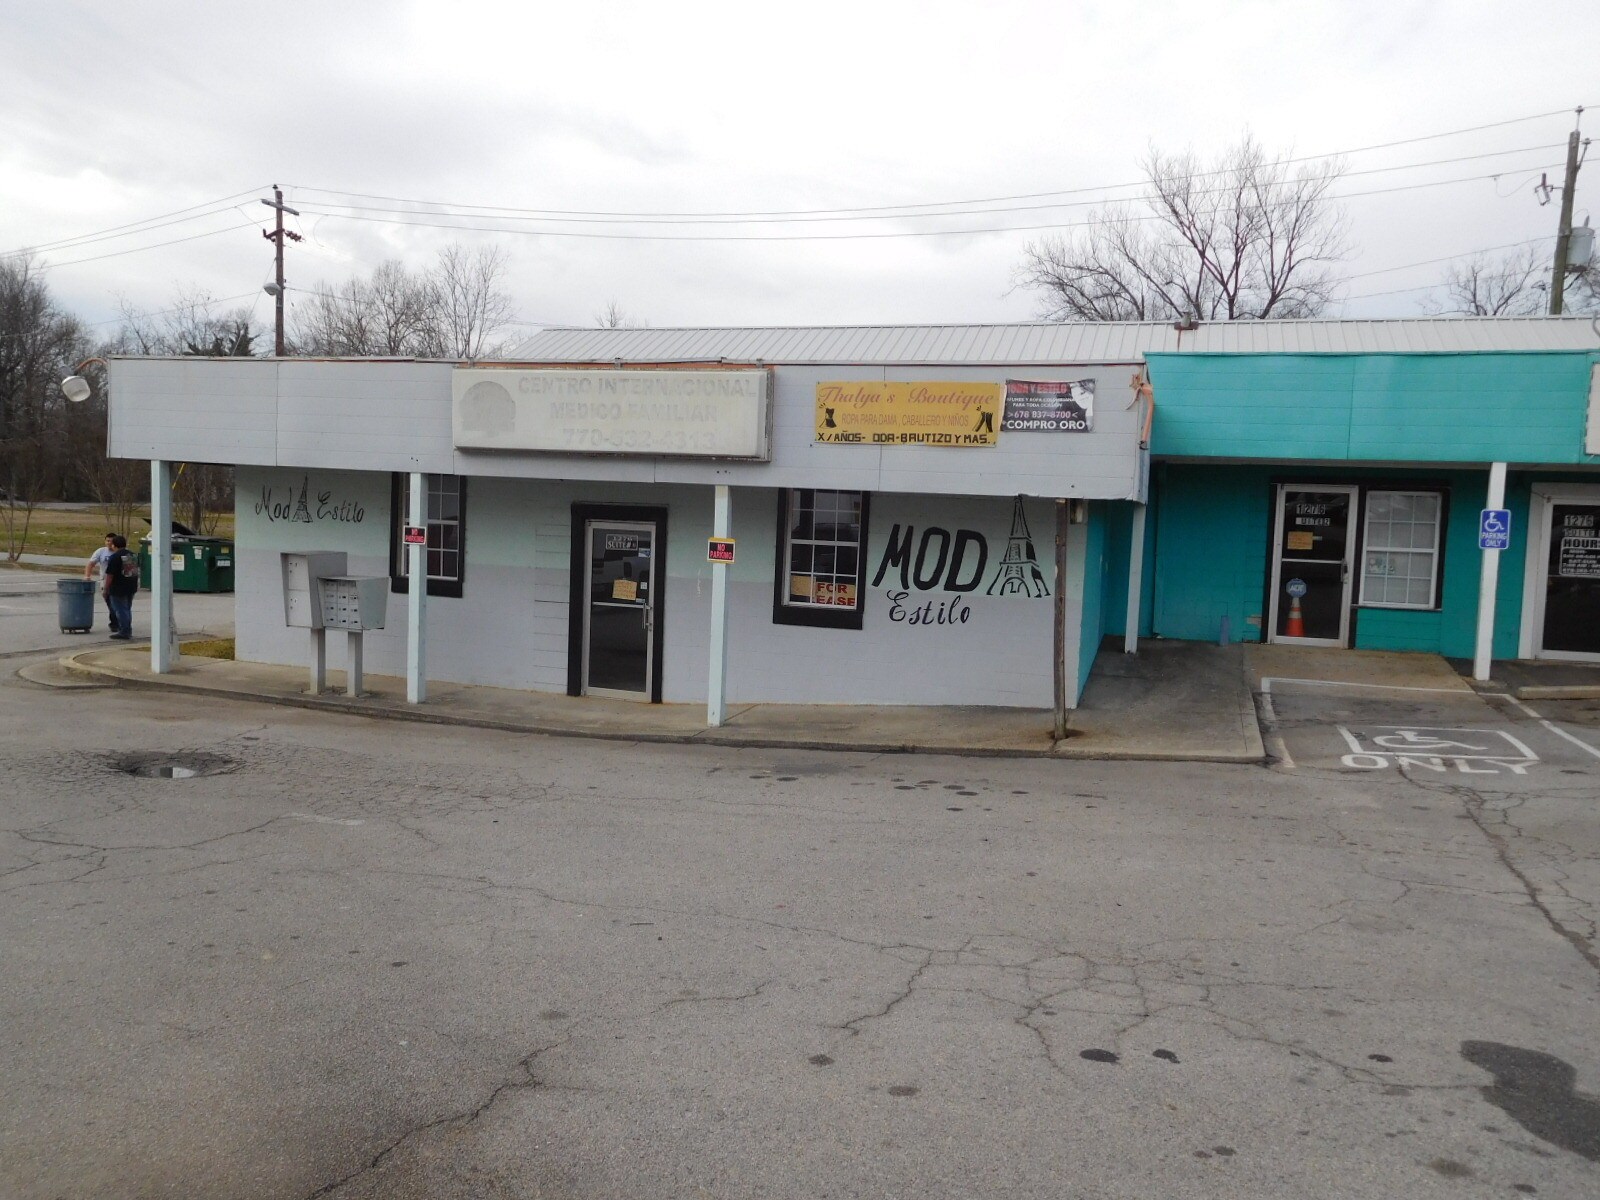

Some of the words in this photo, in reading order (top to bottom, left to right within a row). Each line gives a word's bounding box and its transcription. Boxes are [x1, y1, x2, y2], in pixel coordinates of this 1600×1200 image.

[518, 377, 592, 394] CENTRO
[598, 379, 757, 398] INTERNACIONAL
[817, 383, 896, 409] Thalya's
[908, 387, 994, 411] Boutique
[550, 402, 621, 420] MEDICO
[841, 413, 860, 424] ROPA
[860, 414, 878, 425] PARA
[902, 414, 942, 427] CABALLERO
[942, 415, 949, 426] Y
[949, 413, 969, 427] NIÑOS
[1007, 420, 1057, 430] COMPRO
[1059, 421, 1086, 430] ORO
[316, 490, 365, 523] Estilo
[1296, 503, 1326, 515] 1276
[1564, 515, 1593, 527] 1276
[1480, 531, 1507, 540] PARKING
[717, 543, 726, 551] NO
[1485, 539, 1502, 547] ONLY
[709, 550, 732, 560] PARKING
[817, 582, 848, 594] FOR
[813, 595, 856, 607] EASE
[886, 588, 972, 626] Estilo
[1340, 754, 1541, 775] ONLY
